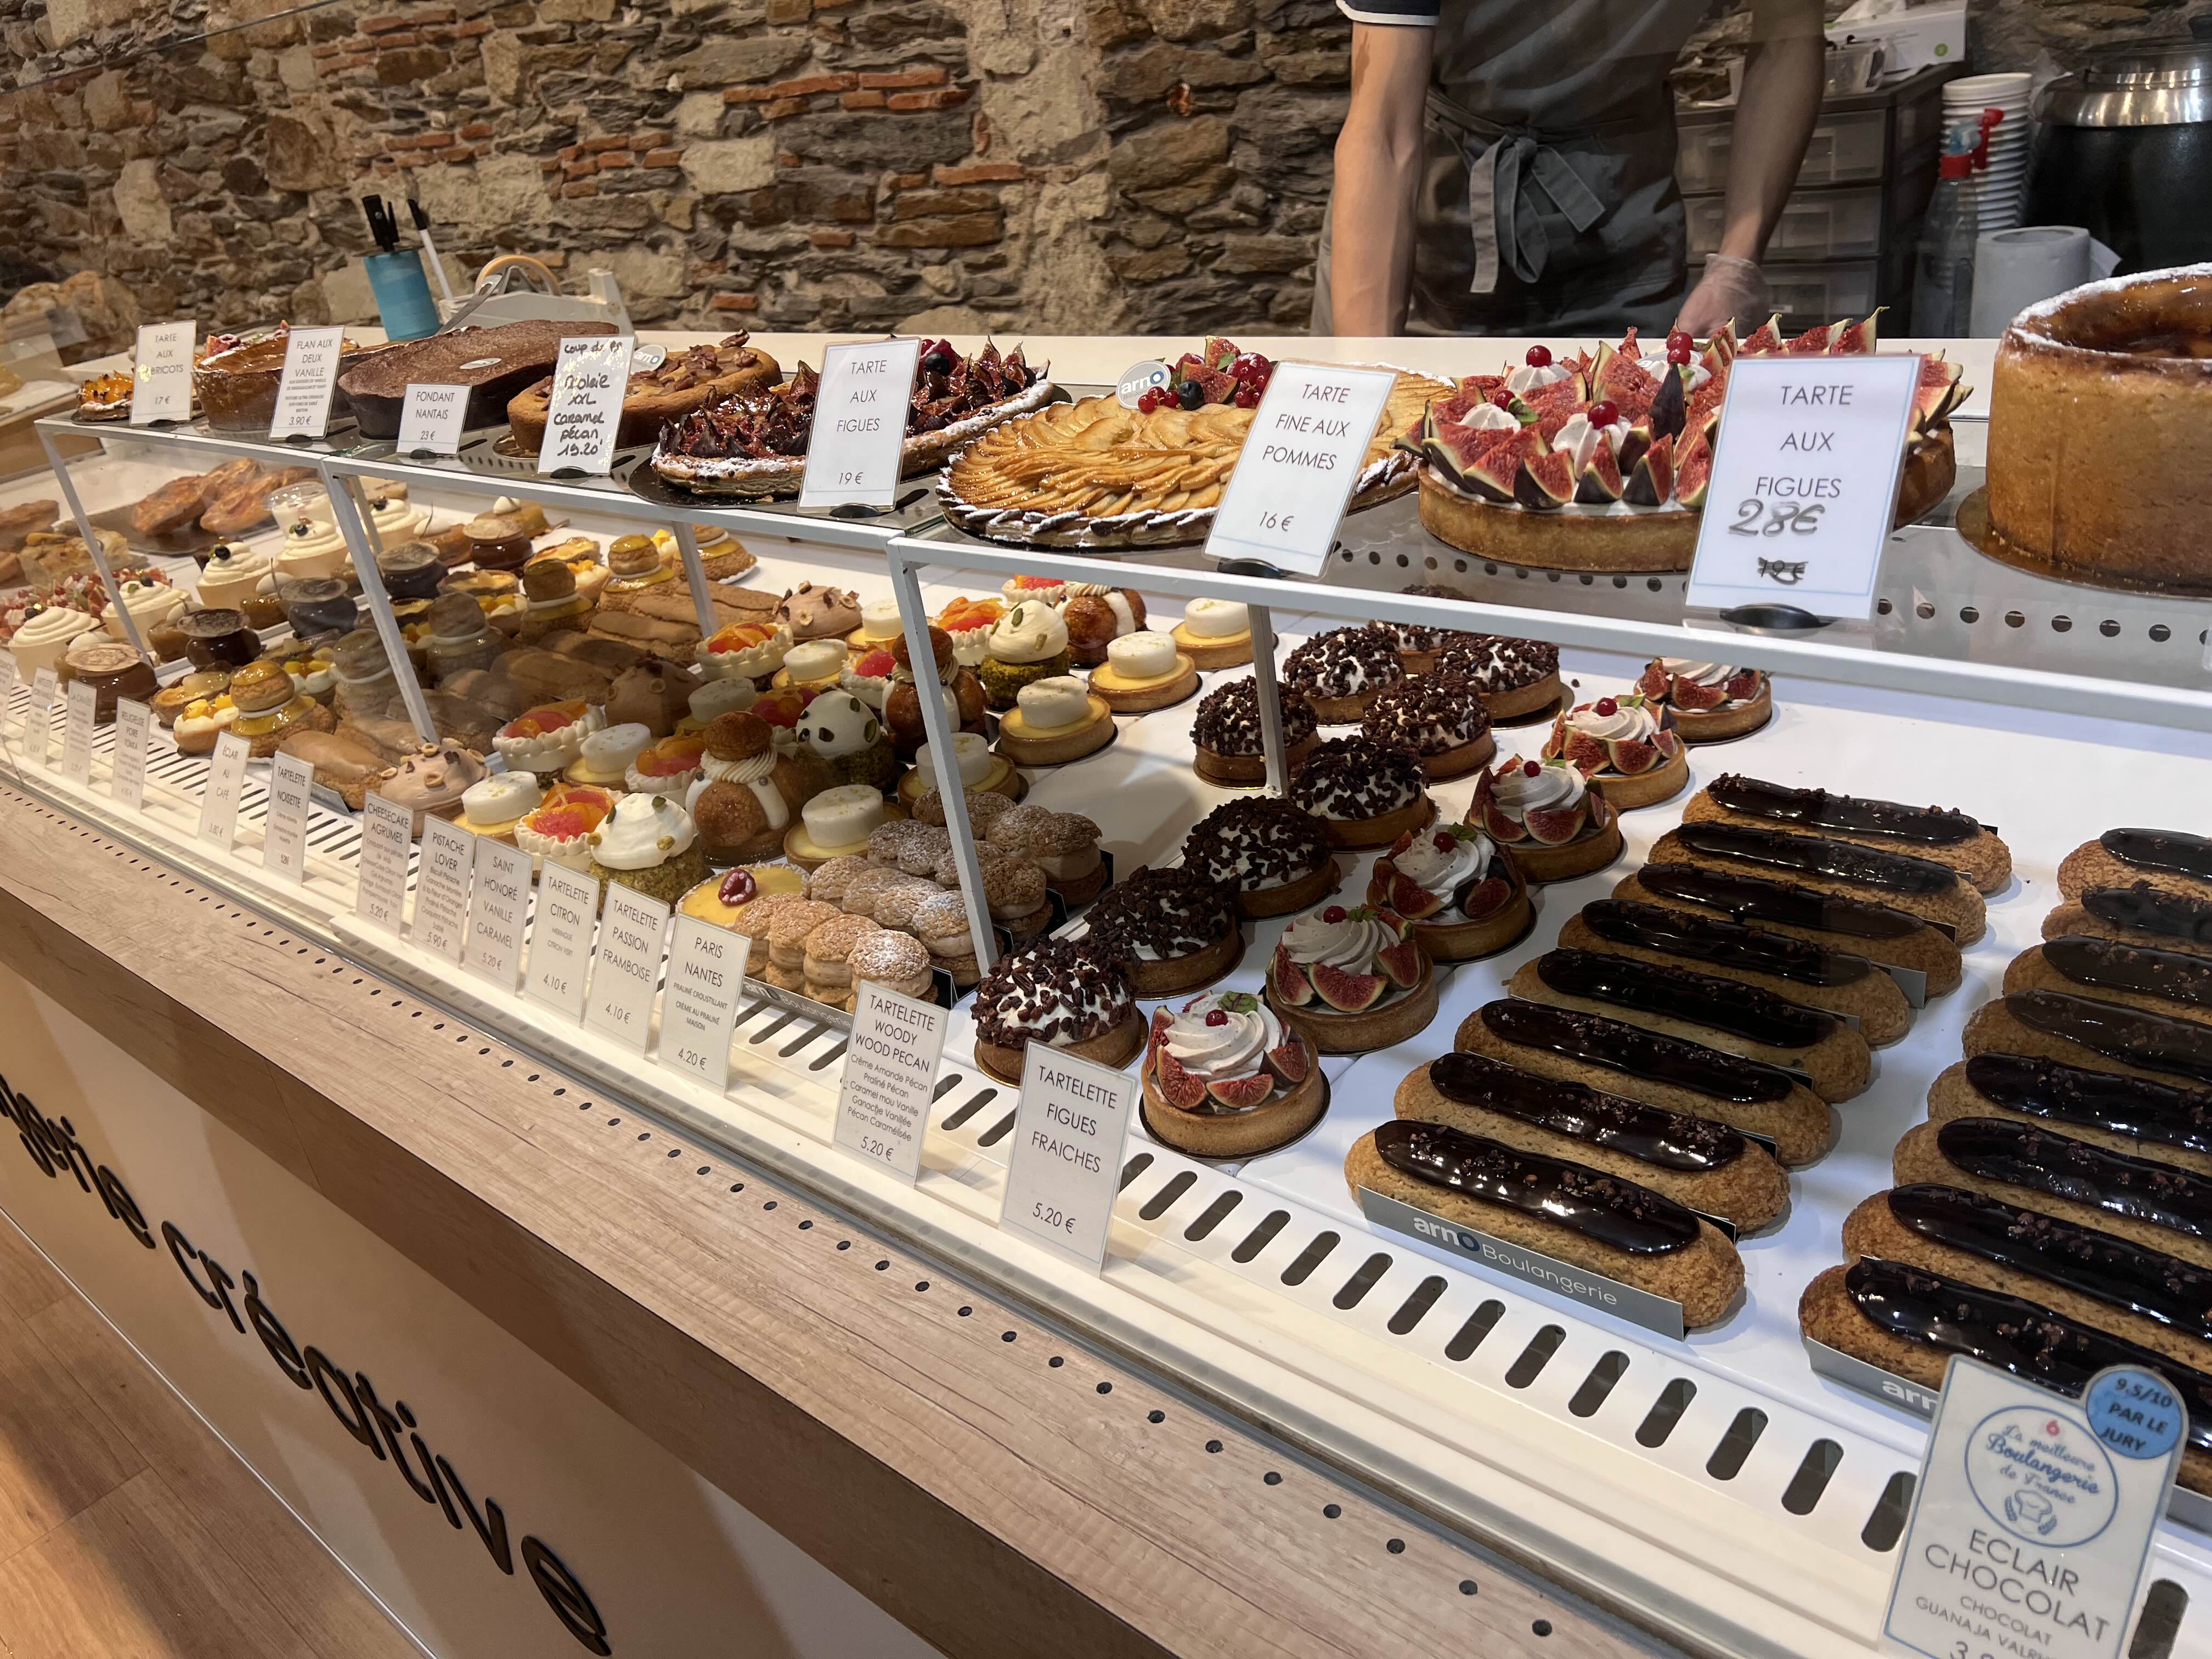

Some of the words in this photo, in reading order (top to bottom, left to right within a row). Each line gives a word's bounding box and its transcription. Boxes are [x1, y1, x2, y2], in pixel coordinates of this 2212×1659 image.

[155, 334, 177, 342] TARTE
[297, 341, 315, 349] FLAN
[317, 339, 333, 348] AUX
[157, 350, 173, 358] AUX
[302, 354, 322, 363] DEUX
[146, 364, 184, 375] BRICOTS
[295, 367, 324, 377] VANILLE
[851, 360, 887, 374] TARTE
[416, 391, 455, 402] FONDANT
[850, 390, 877, 403] AUX
[1302, 384, 1351, 404] TARTE
[1781, 385, 1854, 405] TARTE
[289, 416, 304, 426] 3.90
[415, 409, 449, 420] NANTAIS
[837, 418, 880, 432] FIGUES
[420, 430, 429, 440] 23
[1275, 414, 1312, 432] FINE
[1311, 420, 1351, 438] AUX
[1780, 432, 1835, 452] AUX
[1262, 445, 1338, 471] POMMES
[839, 472, 852, 484] 19
[855, 472, 864, 484] €
[1755, 476, 1842, 498] FIGUES
[1260, 511, 1276, 529] 16
[1281, 516, 1294, 532] €
[278, 766, 306, 786] TARTELETTE
[277, 790, 301, 808] NOISETTE
[368, 803, 409, 829] CHEESECAKE
[371, 822, 403, 844] AGRUMES
[432, 832, 465, 856] PISTACHE
[435, 851, 458, 872] LOVER
[493, 856, 514, 874] SAINT
[484, 877, 517, 901] HONORÉ
[549, 876, 589, 905] TARTELETTE
[370, 904, 383, 918] 5.20
[484, 900, 513, 923] VANILLE
[550, 904, 580, 926] CITRON
[613, 899, 658, 931] TARTELETTE
[427, 932, 441, 947] 5.90
[477, 922, 513, 949] CARAMEL
[612, 926, 649, 954] PASSION
[695, 936, 723, 959] PARIS
[482, 952, 496, 967] 5.20
[603, 948, 651, 983] FRAMBOISE
[543, 974, 560, 990] 4.10
[685, 961, 723, 988] NANTES
[693, 990, 728, 1009] CROUSTILLANT
[605, 1003, 623, 1020] 4.10
[692, 1008, 699, 1016] AU
[870, 994, 935, 1032] TARTELETTE
[686, 1017, 706, 1031] MAISON
[875, 1019, 918, 1046] WOODY
[678, 1047, 698, 1066] 4.20
[699, 1057, 707, 1070] €
[855, 1033, 890, 1057] WOOD
[893, 1048, 930, 1073] PECAN
[851, 1054, 873, 1070] Crème
[874, 1064, 904, 1082] Amande
[905, 1075, 928, 1092] Pécan
[864, 1073, 885, 1088] Praliné
[887, 1082, 909, 1099] Pécan
[1039, 1065, 1117, 1109] TARTELETTE
[848, 1106, 868, 1122] Pécan
[852, 1095, 883, 1115] Ganache
[879, 1094, 895, 1107] mou
[896, 1099, 918, 1116] Vanille
[1047, 1103, 1097, 1136] FIGUES
[861, 1136, 884, 1156] 5.20
[885, 1147, 894, 1162] €
[1032, 1131, 1101, 1173] FRAICHES
[1032, 1202, 1062, 1227] 5.20
[1065, 1217, 1076, 1234] €
[1482, 1244, 1618, 1306] Boulangerie
[2115, 1378, 2173, 1408] 9.5/10
[2108, 1402, 2145, 1426] PAR
[2147, 1417, 2168, 1436] LE
[161, 1220, 612, 1657] créative
[2101, 1427, 2147, 1452] JURY
[1986, 1433, 2099, 1493] Boulangerie
[1970, 1529, 2079, 1596] ECLAIR
[1926, 1544, 2110, 1643] CHOCOLAT
[1916, 1596, 1990, 1641] GUANAJA
[1960, 1596, 2052, 1646] CHOCOLAT
